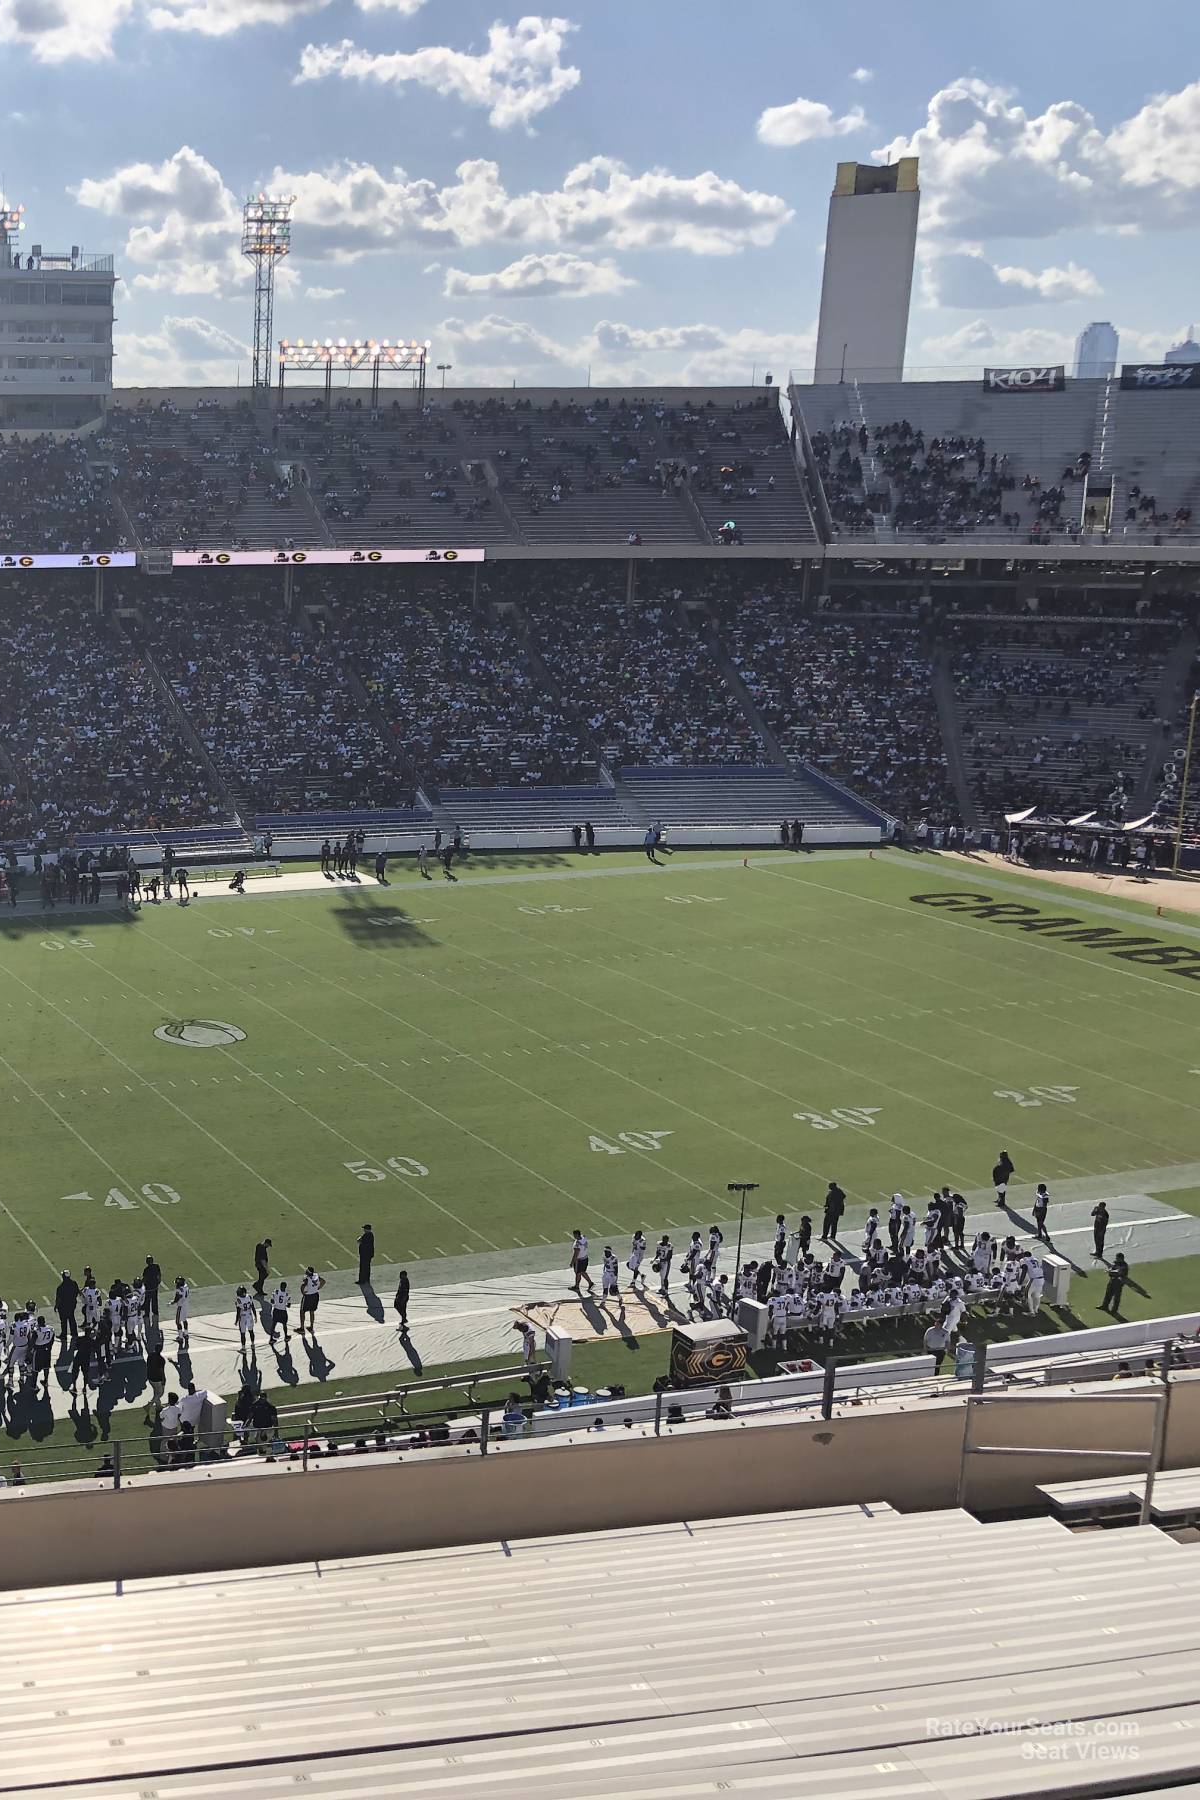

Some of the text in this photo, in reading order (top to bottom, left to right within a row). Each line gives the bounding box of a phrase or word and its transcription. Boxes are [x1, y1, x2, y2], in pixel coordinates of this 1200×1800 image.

[990, 369, 1056, 388] K104
[993, 1086, 1077, 1107] 20
[792, 1109, 876, 1130] 30
[589, 1132, 662, 1154] 40
[343, 1157, 430, 1183] 50
[104, 1183, 181, 1210] 40
[43, 1331, 50, 1340] 73
